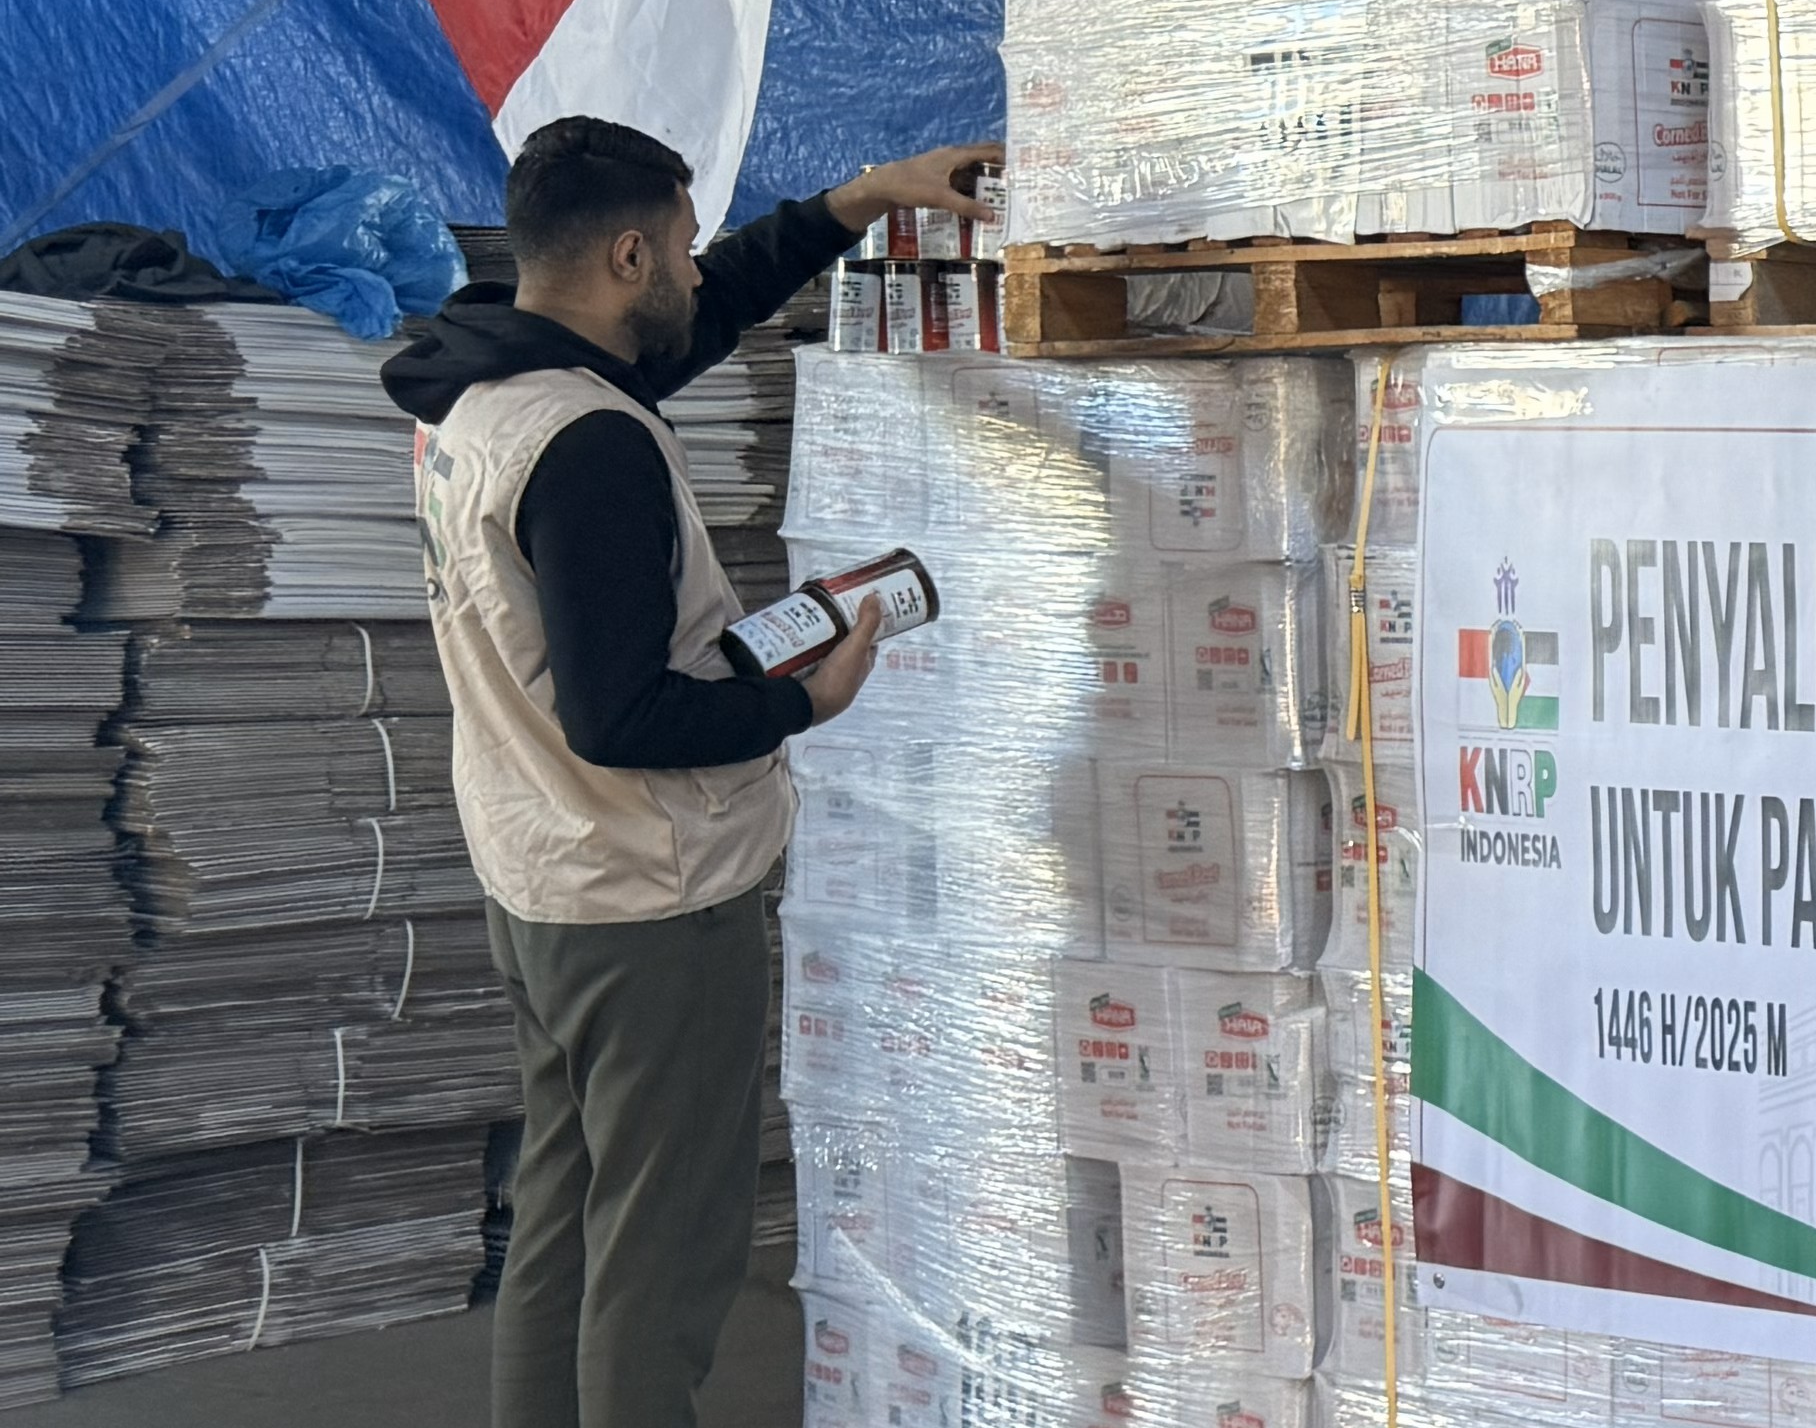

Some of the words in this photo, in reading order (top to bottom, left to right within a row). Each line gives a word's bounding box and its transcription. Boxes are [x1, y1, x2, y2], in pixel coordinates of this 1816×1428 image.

[1459, 745, 1558, 819] KNRP
[1460, 828, 1562, 870] INDONESIA
[1589, 785, 1746, 944] UNTUK
[1593, 986, 1652, 1063] 1446
[1661, 992, 1759, 1077] H/2025
[1765, 999, 1787, 1077] M
